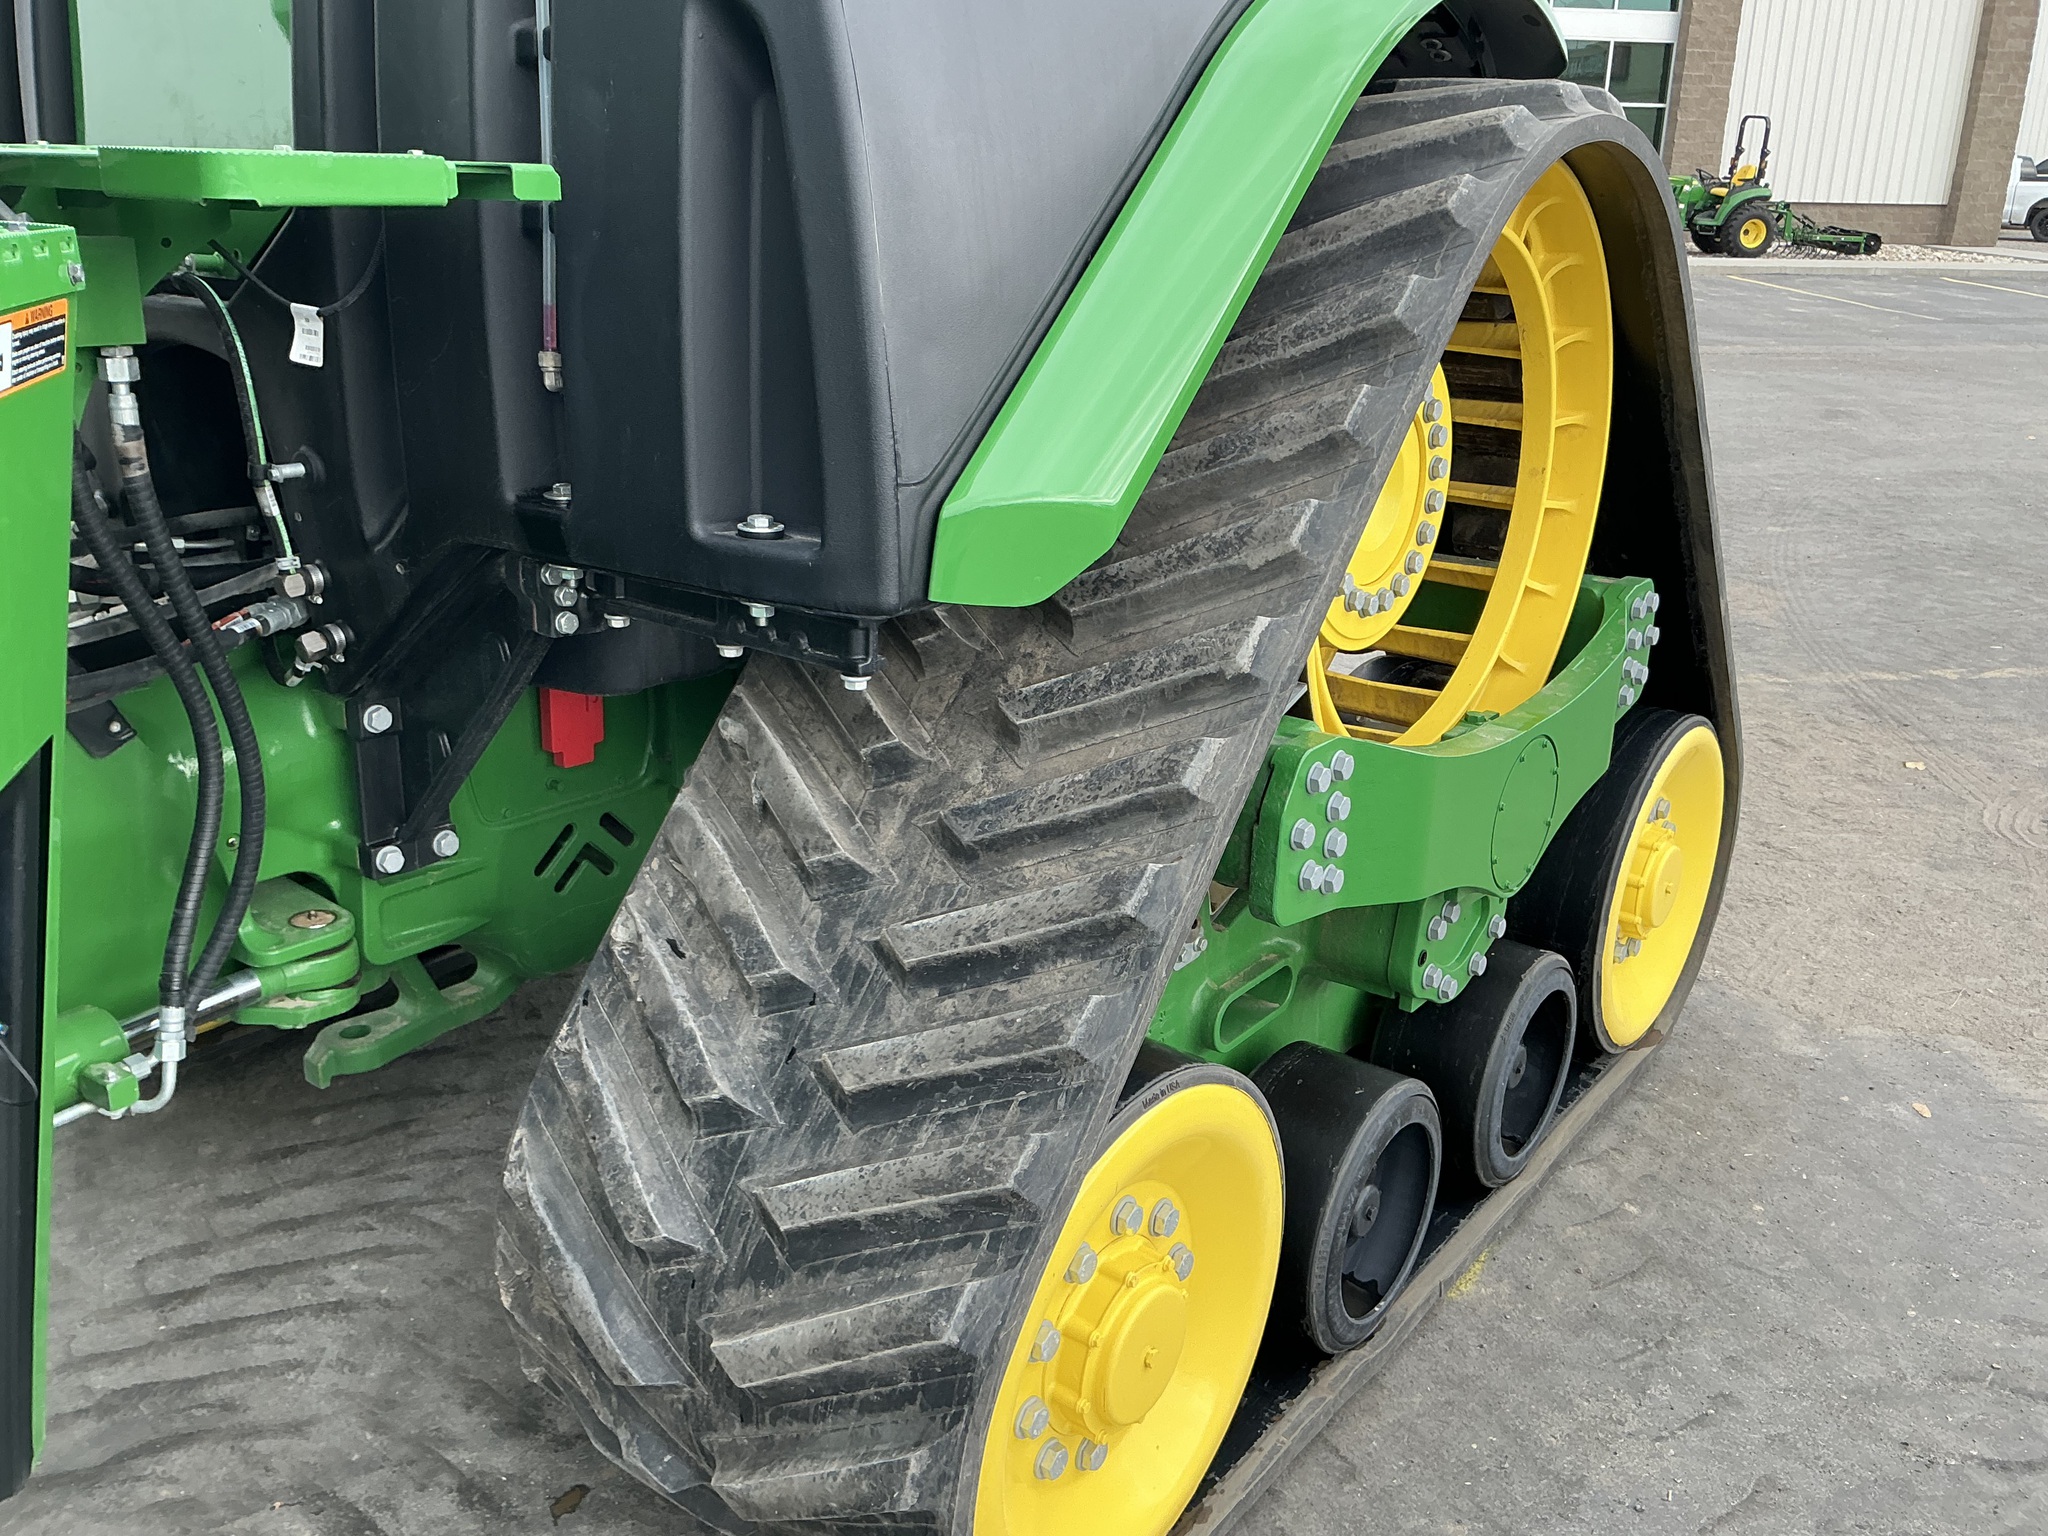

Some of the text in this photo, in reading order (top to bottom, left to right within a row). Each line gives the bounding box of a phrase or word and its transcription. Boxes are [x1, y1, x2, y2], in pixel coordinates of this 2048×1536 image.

[30, 304, 53, 320] WARNING
[1142, 1093, 1160, 1109] Made
[1166, 1080, 1180, 1093] USA
